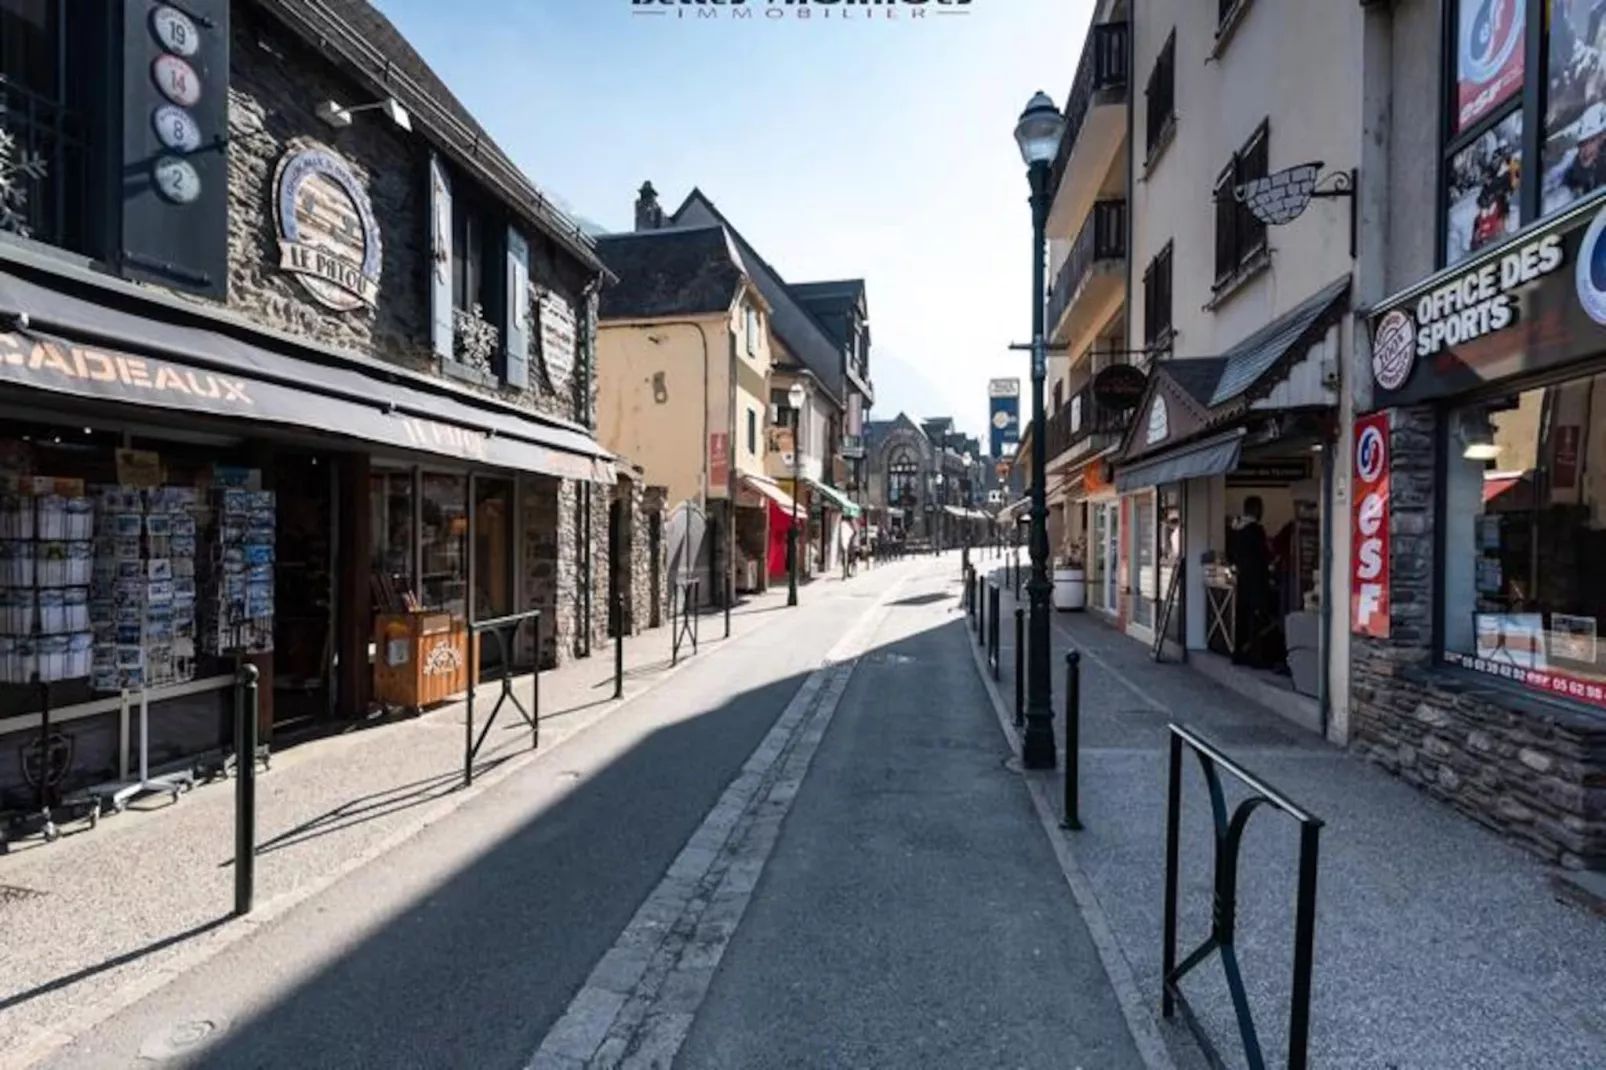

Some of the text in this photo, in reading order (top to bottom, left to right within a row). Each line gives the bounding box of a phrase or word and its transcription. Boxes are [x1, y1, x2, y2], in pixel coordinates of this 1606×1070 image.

[168, 20, 186, 45] 19
[173, 119, 184, 141] 8
[171, 168, 183, 190] 2
[291, 246, 368, 297] LE PATOU
[1416, 234, 1563, 326] OFFICE DES
[1416, 295, 1513, 357] SPORTS
